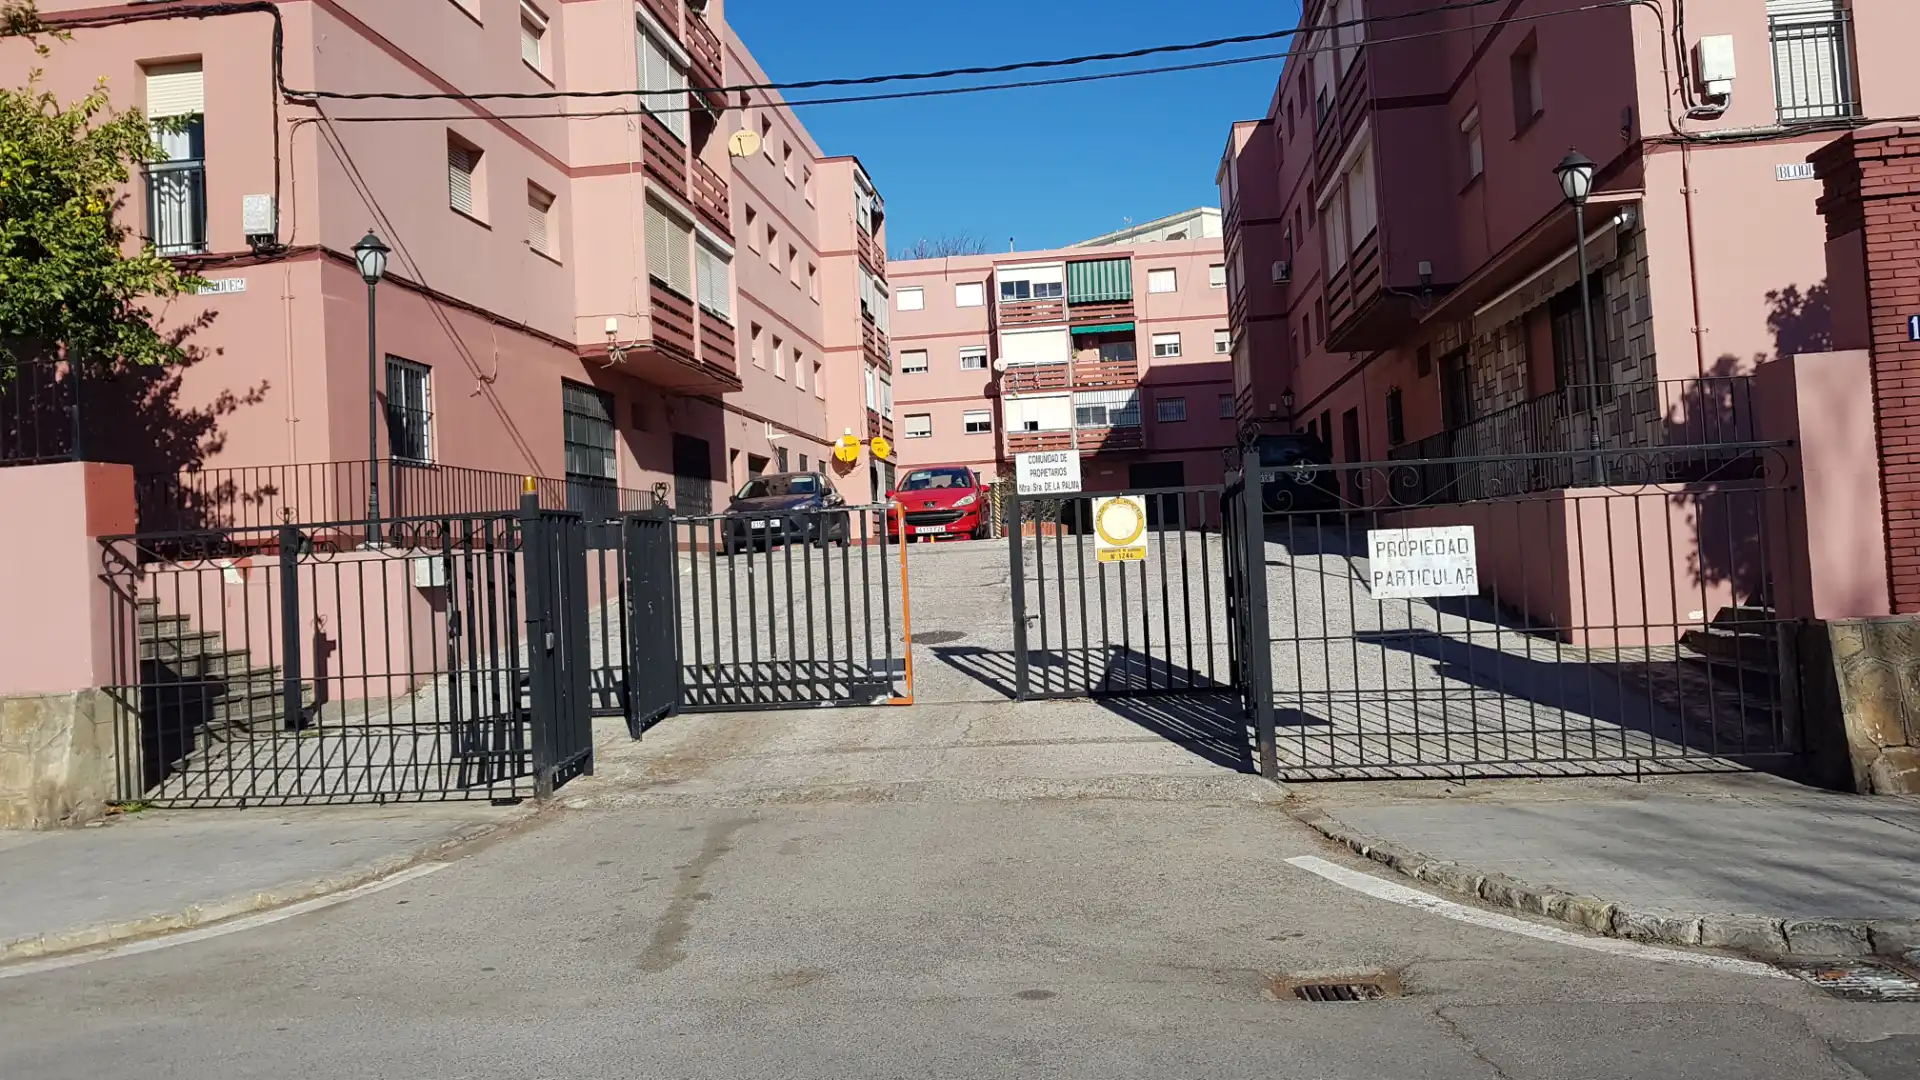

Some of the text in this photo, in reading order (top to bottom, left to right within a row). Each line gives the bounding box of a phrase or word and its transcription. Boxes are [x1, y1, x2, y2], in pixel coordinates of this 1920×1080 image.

[1060, 453, 1068, 463] DE
[1044, 481, 1052, 491] DE
[1053, 481, 1061, 491] LA
[1061, 480, 1080, 490] PALMA
[1375, 537, 1469, 558] PROPIEDAD
[1374, 567, 1475, 587] PARTICULAR
